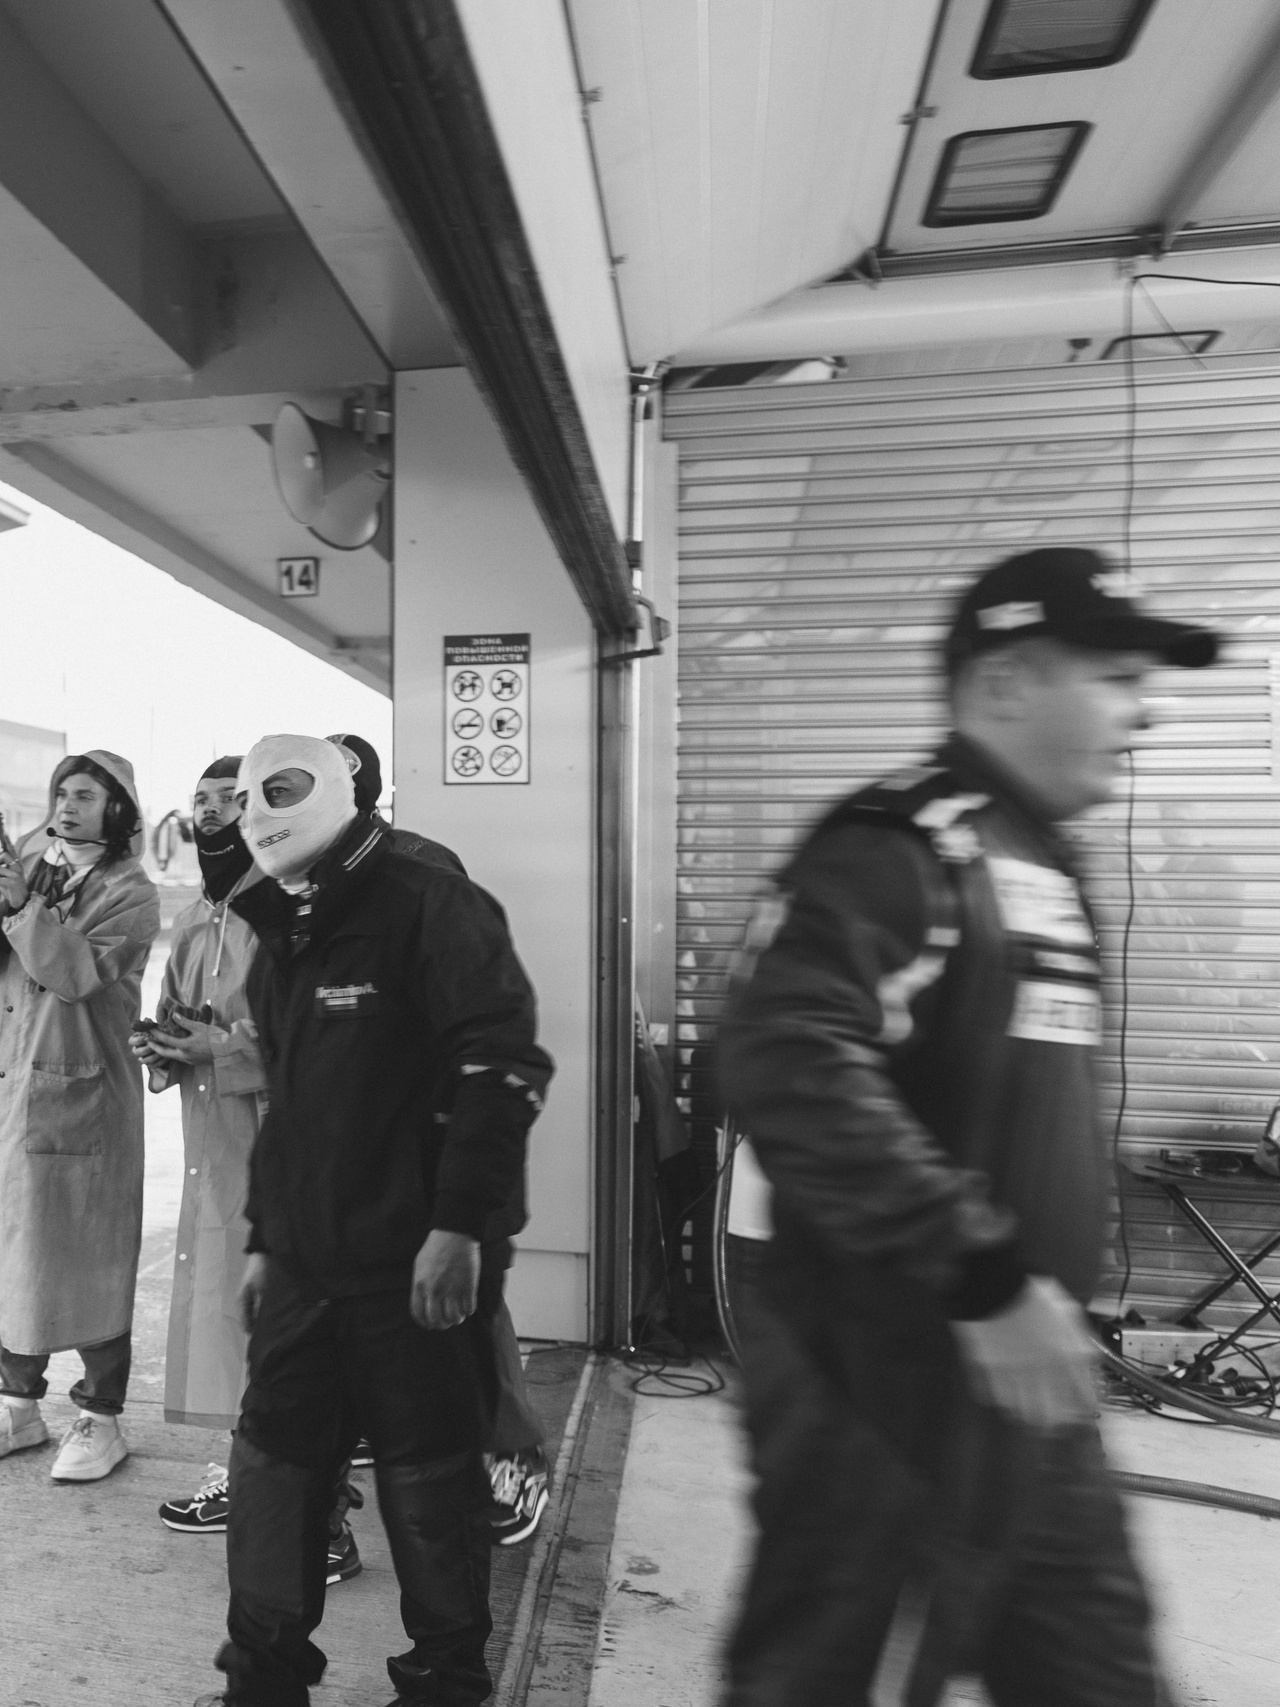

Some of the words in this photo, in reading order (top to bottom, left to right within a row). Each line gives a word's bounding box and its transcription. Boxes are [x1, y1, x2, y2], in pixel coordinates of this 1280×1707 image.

[283, 564, 312, 591] 14
[471, 637, 503, 646] ЗОНА
[453, 654, 524, 663] ОПАСНОСТИ
